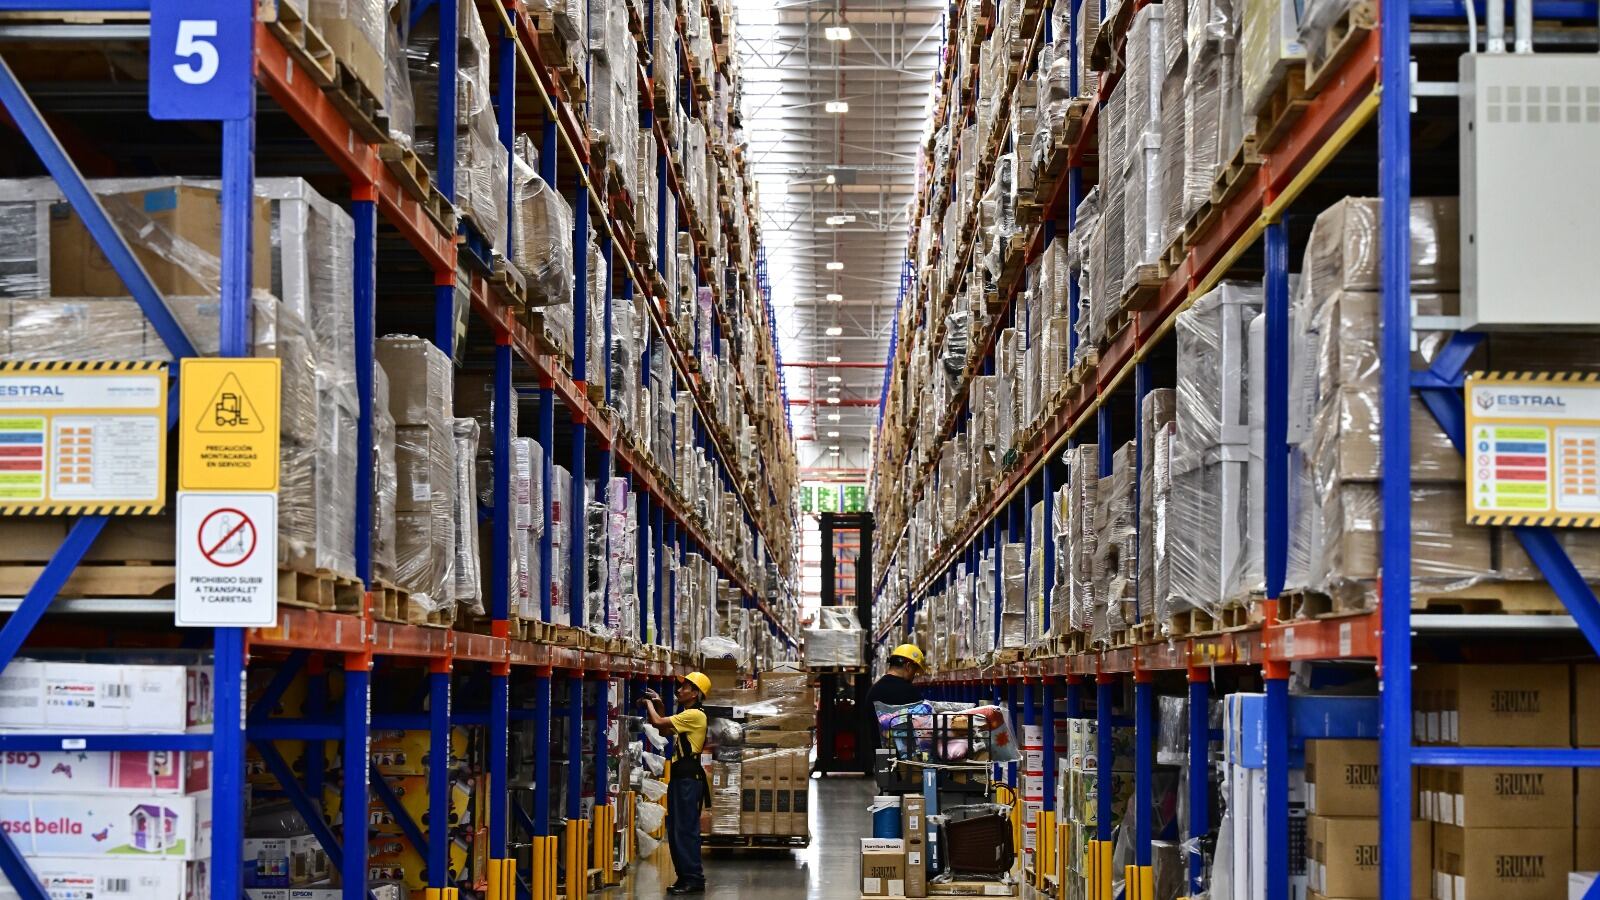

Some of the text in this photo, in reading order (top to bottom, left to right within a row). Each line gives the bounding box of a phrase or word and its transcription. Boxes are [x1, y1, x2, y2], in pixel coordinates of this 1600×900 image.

[173, 20, 219, 86] 5
[1497, 395, 1566, 406] ESTRAL
[190, 576, 263, 584] PROHIBIDO SUBIR
[195, 585, 258, 593] A TRANSPALET
[208, 595, 253, 603] CARRETAS
[1490, 690, 1541, 712] BRUMM
[1493, 773, 1545, 795] BRUMM
[1495, 856, 1545, 877] BRUMM
